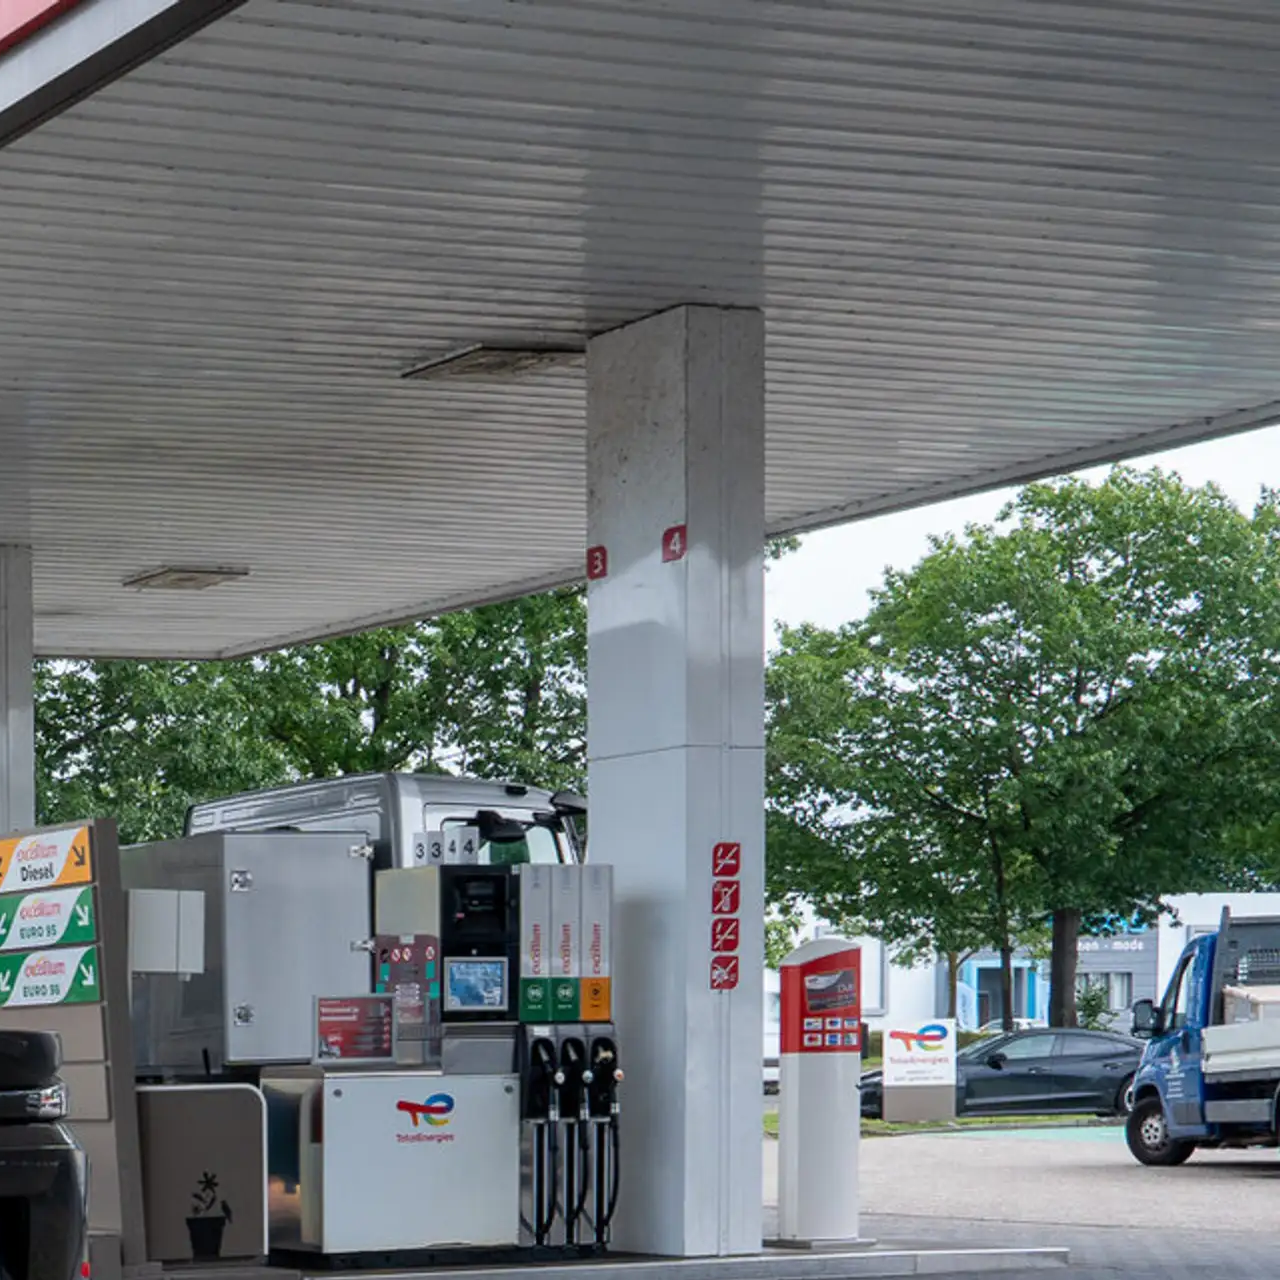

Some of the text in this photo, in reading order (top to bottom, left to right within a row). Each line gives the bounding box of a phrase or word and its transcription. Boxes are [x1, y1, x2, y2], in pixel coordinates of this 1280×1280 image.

[669, 531, 682, 555] 4
[592, 551, 603, 575] 3
[415, 838, 474, 860] 3 3 4 4
[20, 862, 55, 882] Diesel
[20, 927, 44, 939] EURO
[23, 985, 48, 998] EURO
